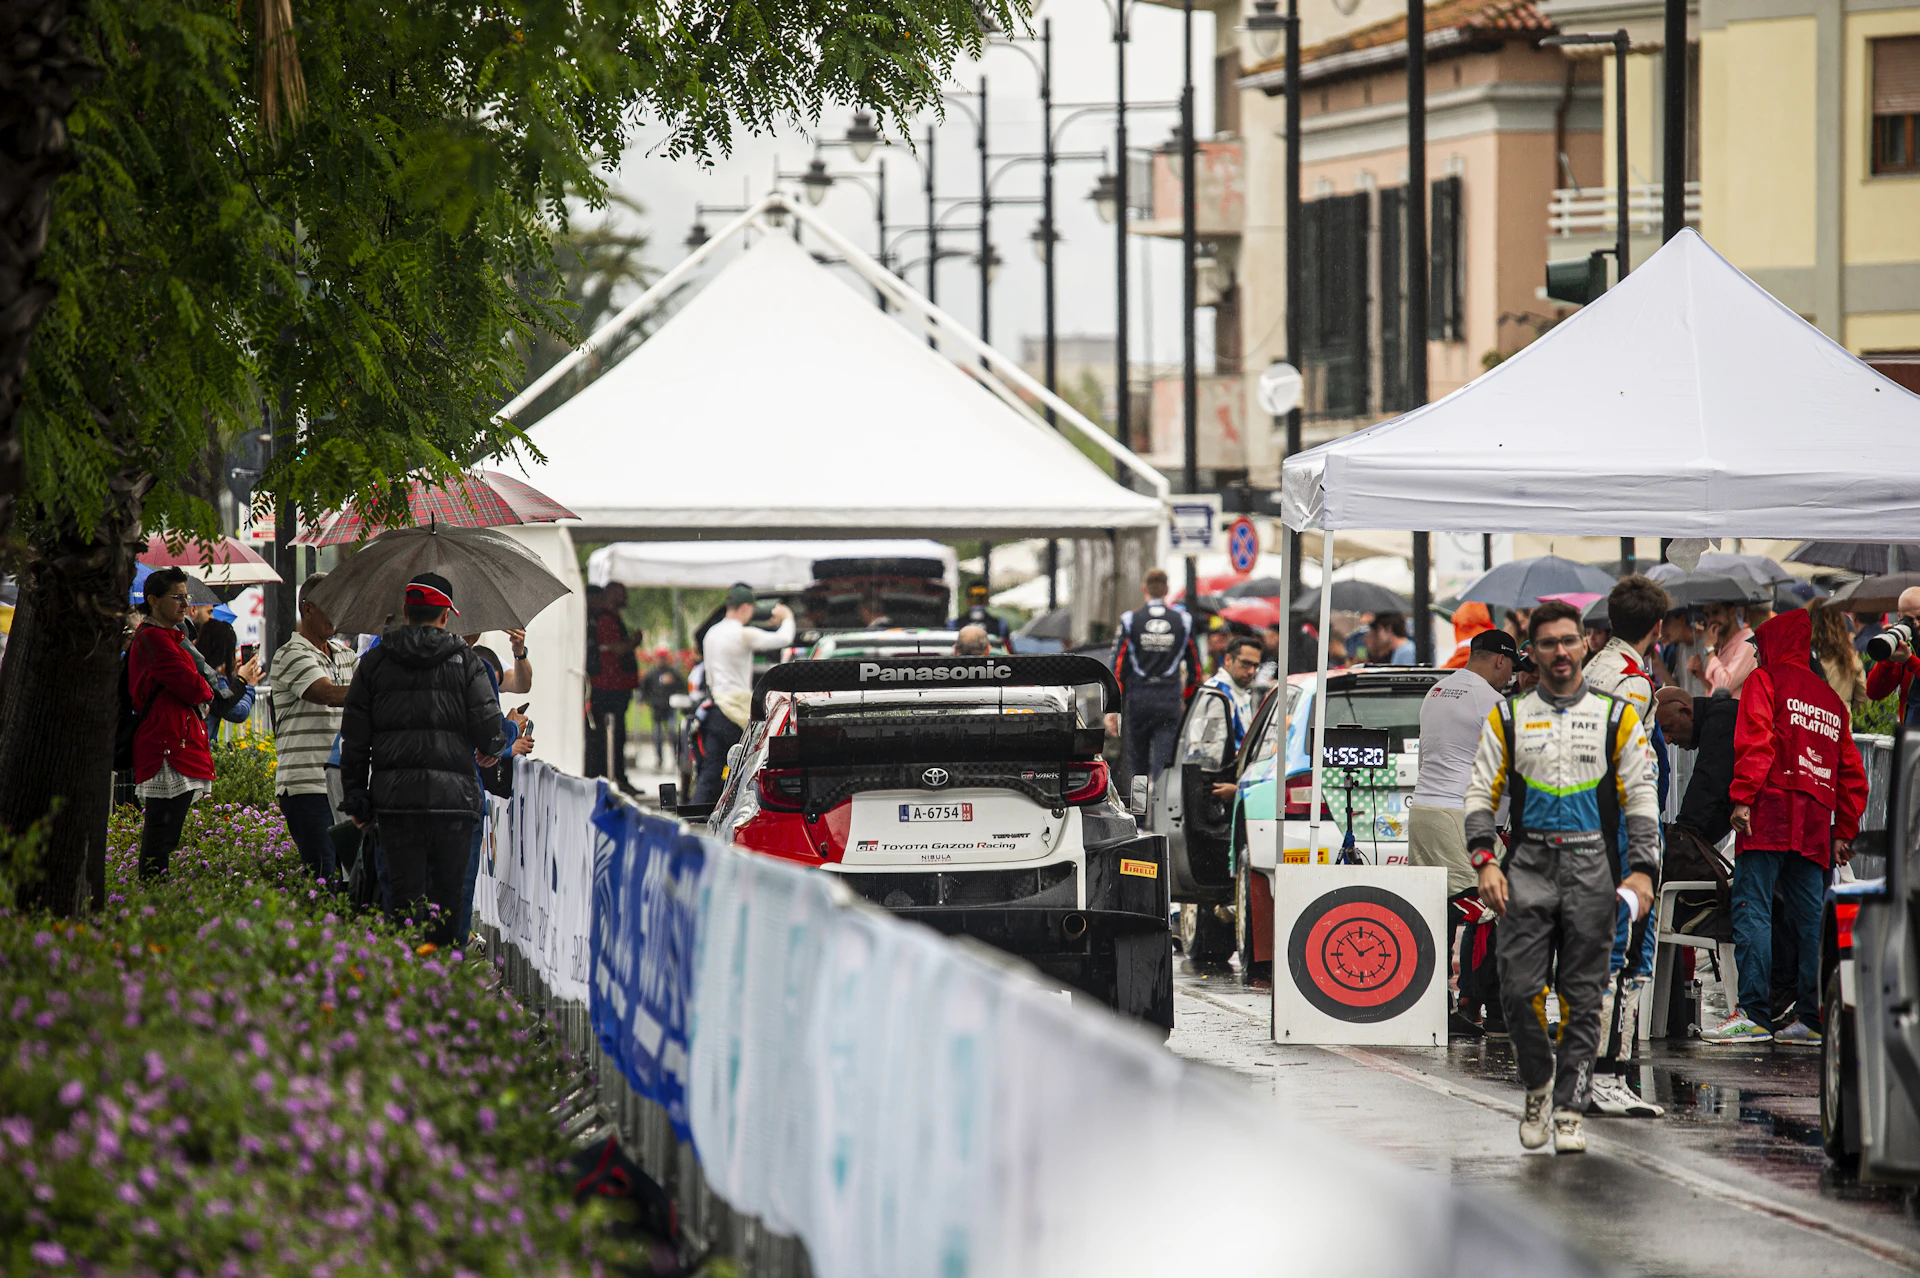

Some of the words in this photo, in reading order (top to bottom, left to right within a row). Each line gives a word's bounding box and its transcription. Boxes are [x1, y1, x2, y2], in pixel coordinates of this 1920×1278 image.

[859, 660, 1012, 682] Panasonic
[1571, 721, 1599, 731] FAFE
[1790, 713, 1840, 742] RELATIONS
[913, 806, 959, 819] A-6754
[931, 842, 974, 850] GAZOO
[976, 841, 1016, 850] Racing
[1124, 862, 1155, 876] PIRELLI
